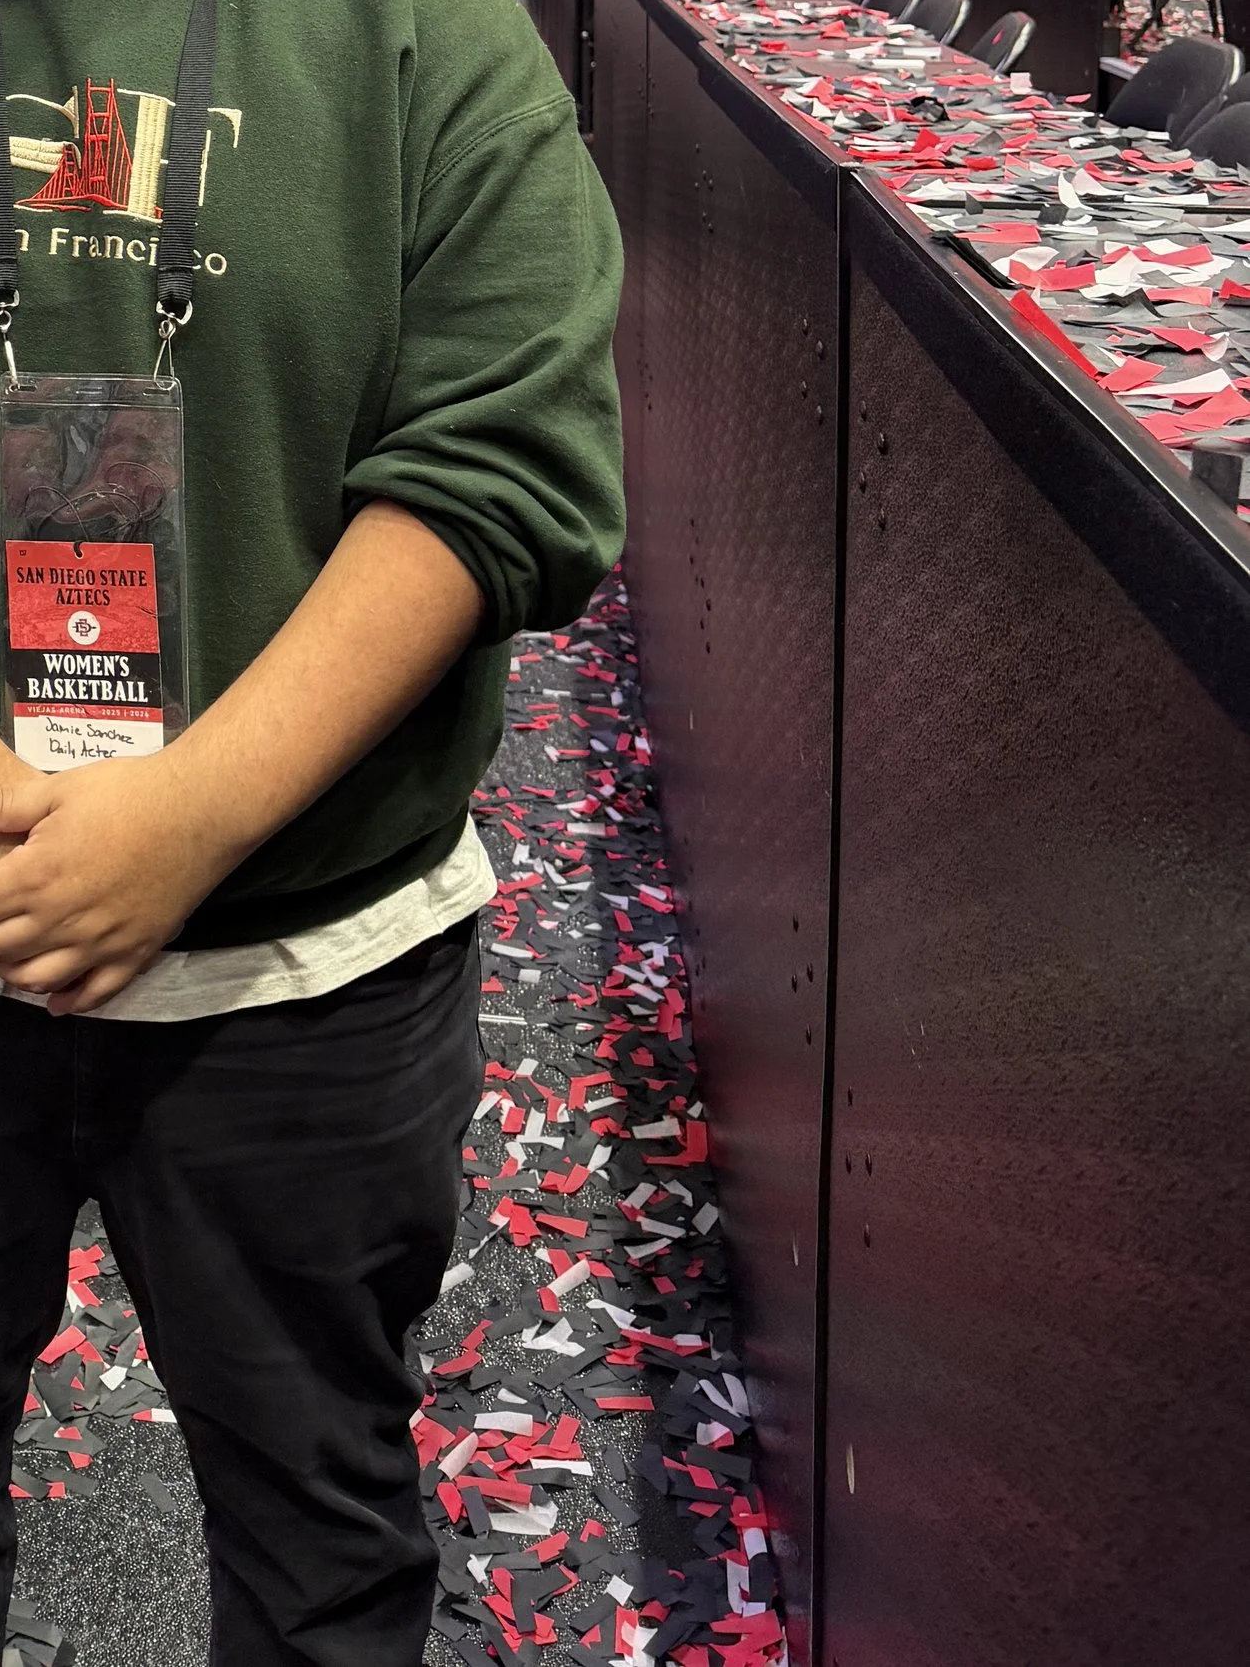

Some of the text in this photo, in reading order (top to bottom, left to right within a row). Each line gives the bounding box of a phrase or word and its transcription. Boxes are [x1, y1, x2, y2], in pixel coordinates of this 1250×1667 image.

[16, 567, 148, 587] SAN DIEGO STATE
[56, 588, 111, 606] AZTECS
[43, 653, 130, 677] WOMEN'S
[27, 678, 149, 703] BASKETBALL
[27, 706, 150, 719] VIEJAS ARENA 2025 2026
[46, 717, 134, 744] Jamie Sanchez
[49, 738, 75, 759] Daily
